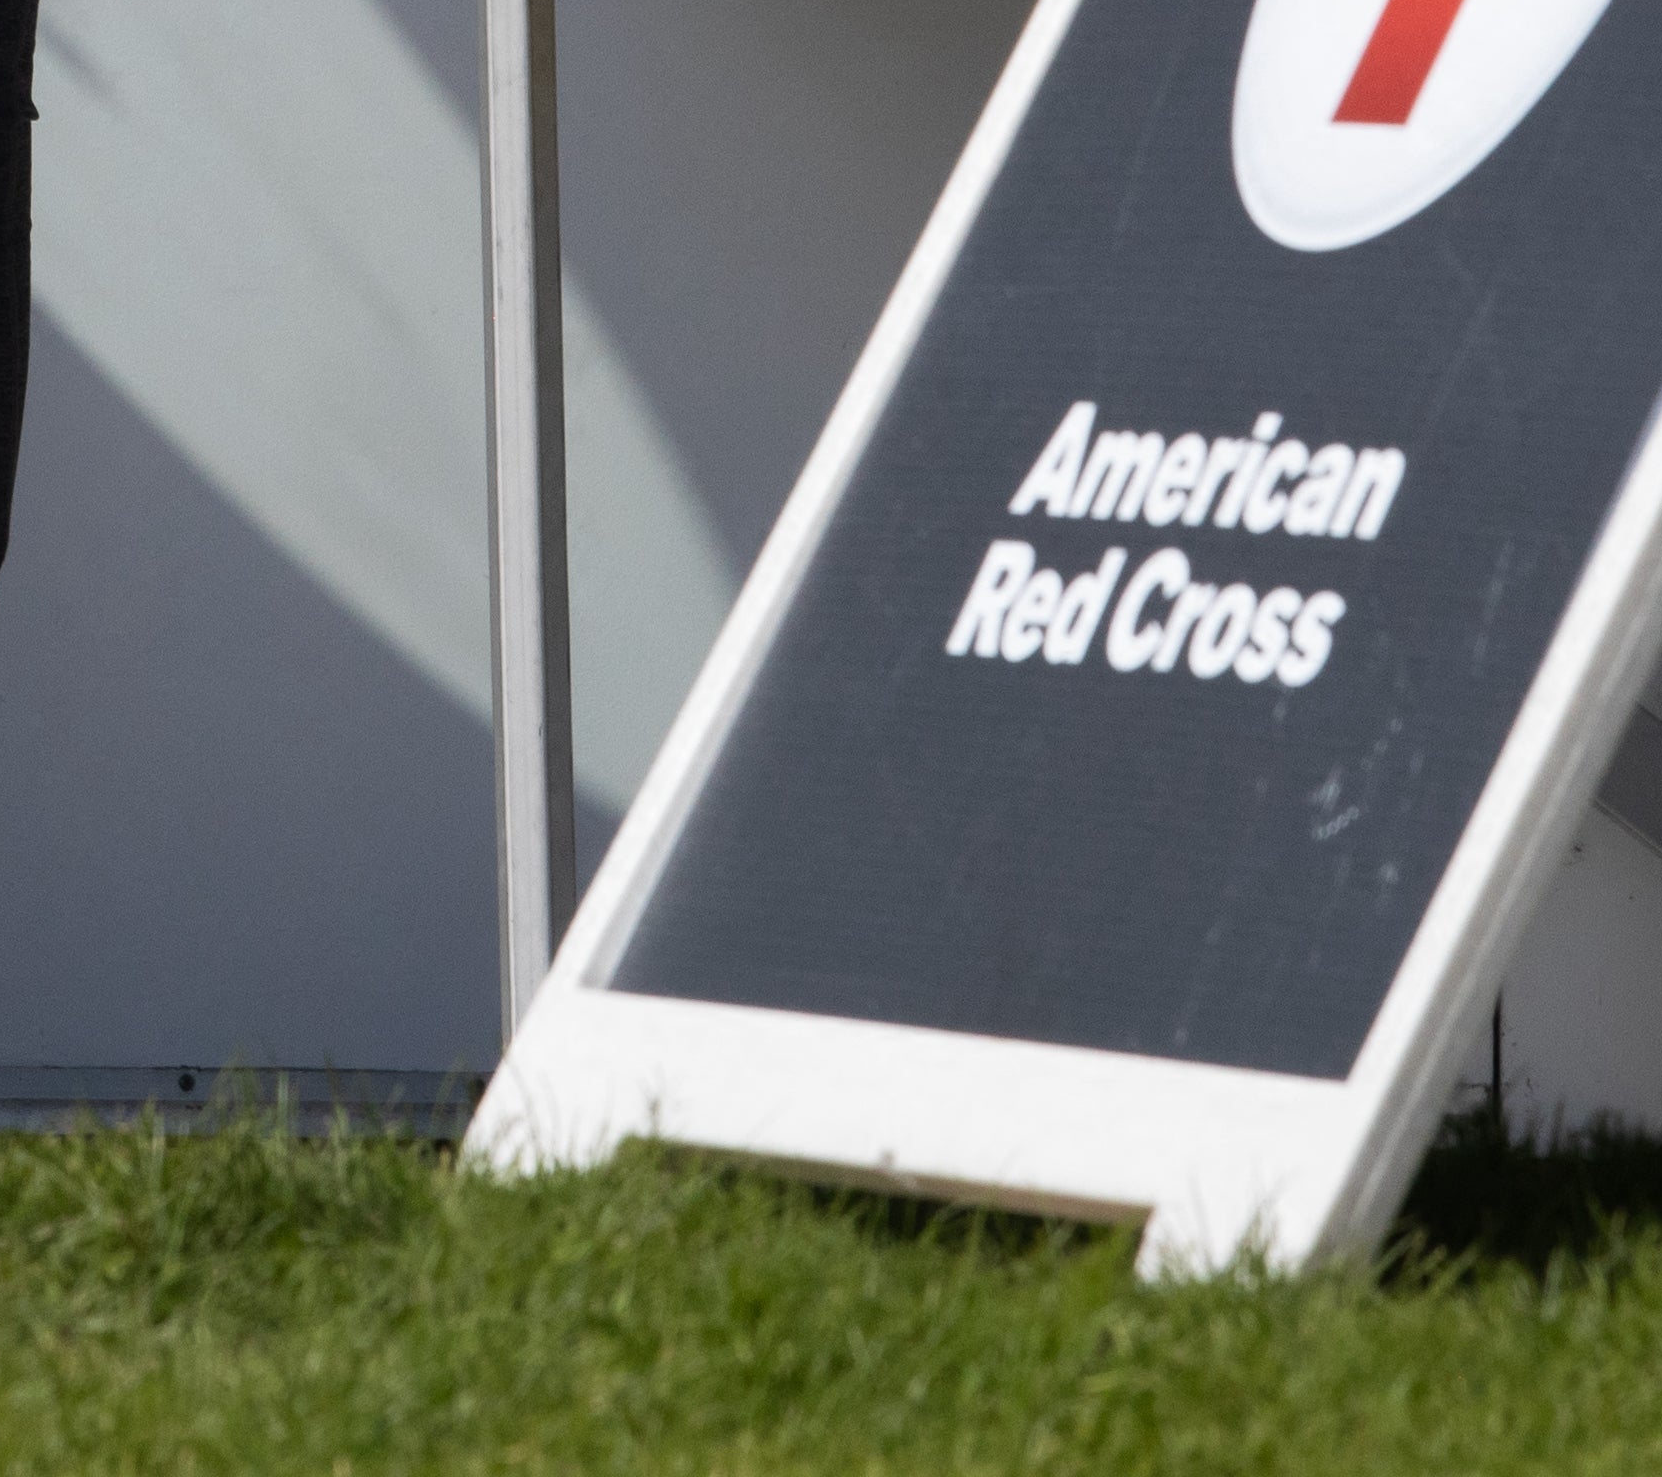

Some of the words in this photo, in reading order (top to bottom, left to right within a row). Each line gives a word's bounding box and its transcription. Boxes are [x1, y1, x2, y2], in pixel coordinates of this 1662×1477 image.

[1007, 400, 1407, 541] American
[945, 539, 1128, 666] Red
[1106, 546, 1347, 688] Cross
